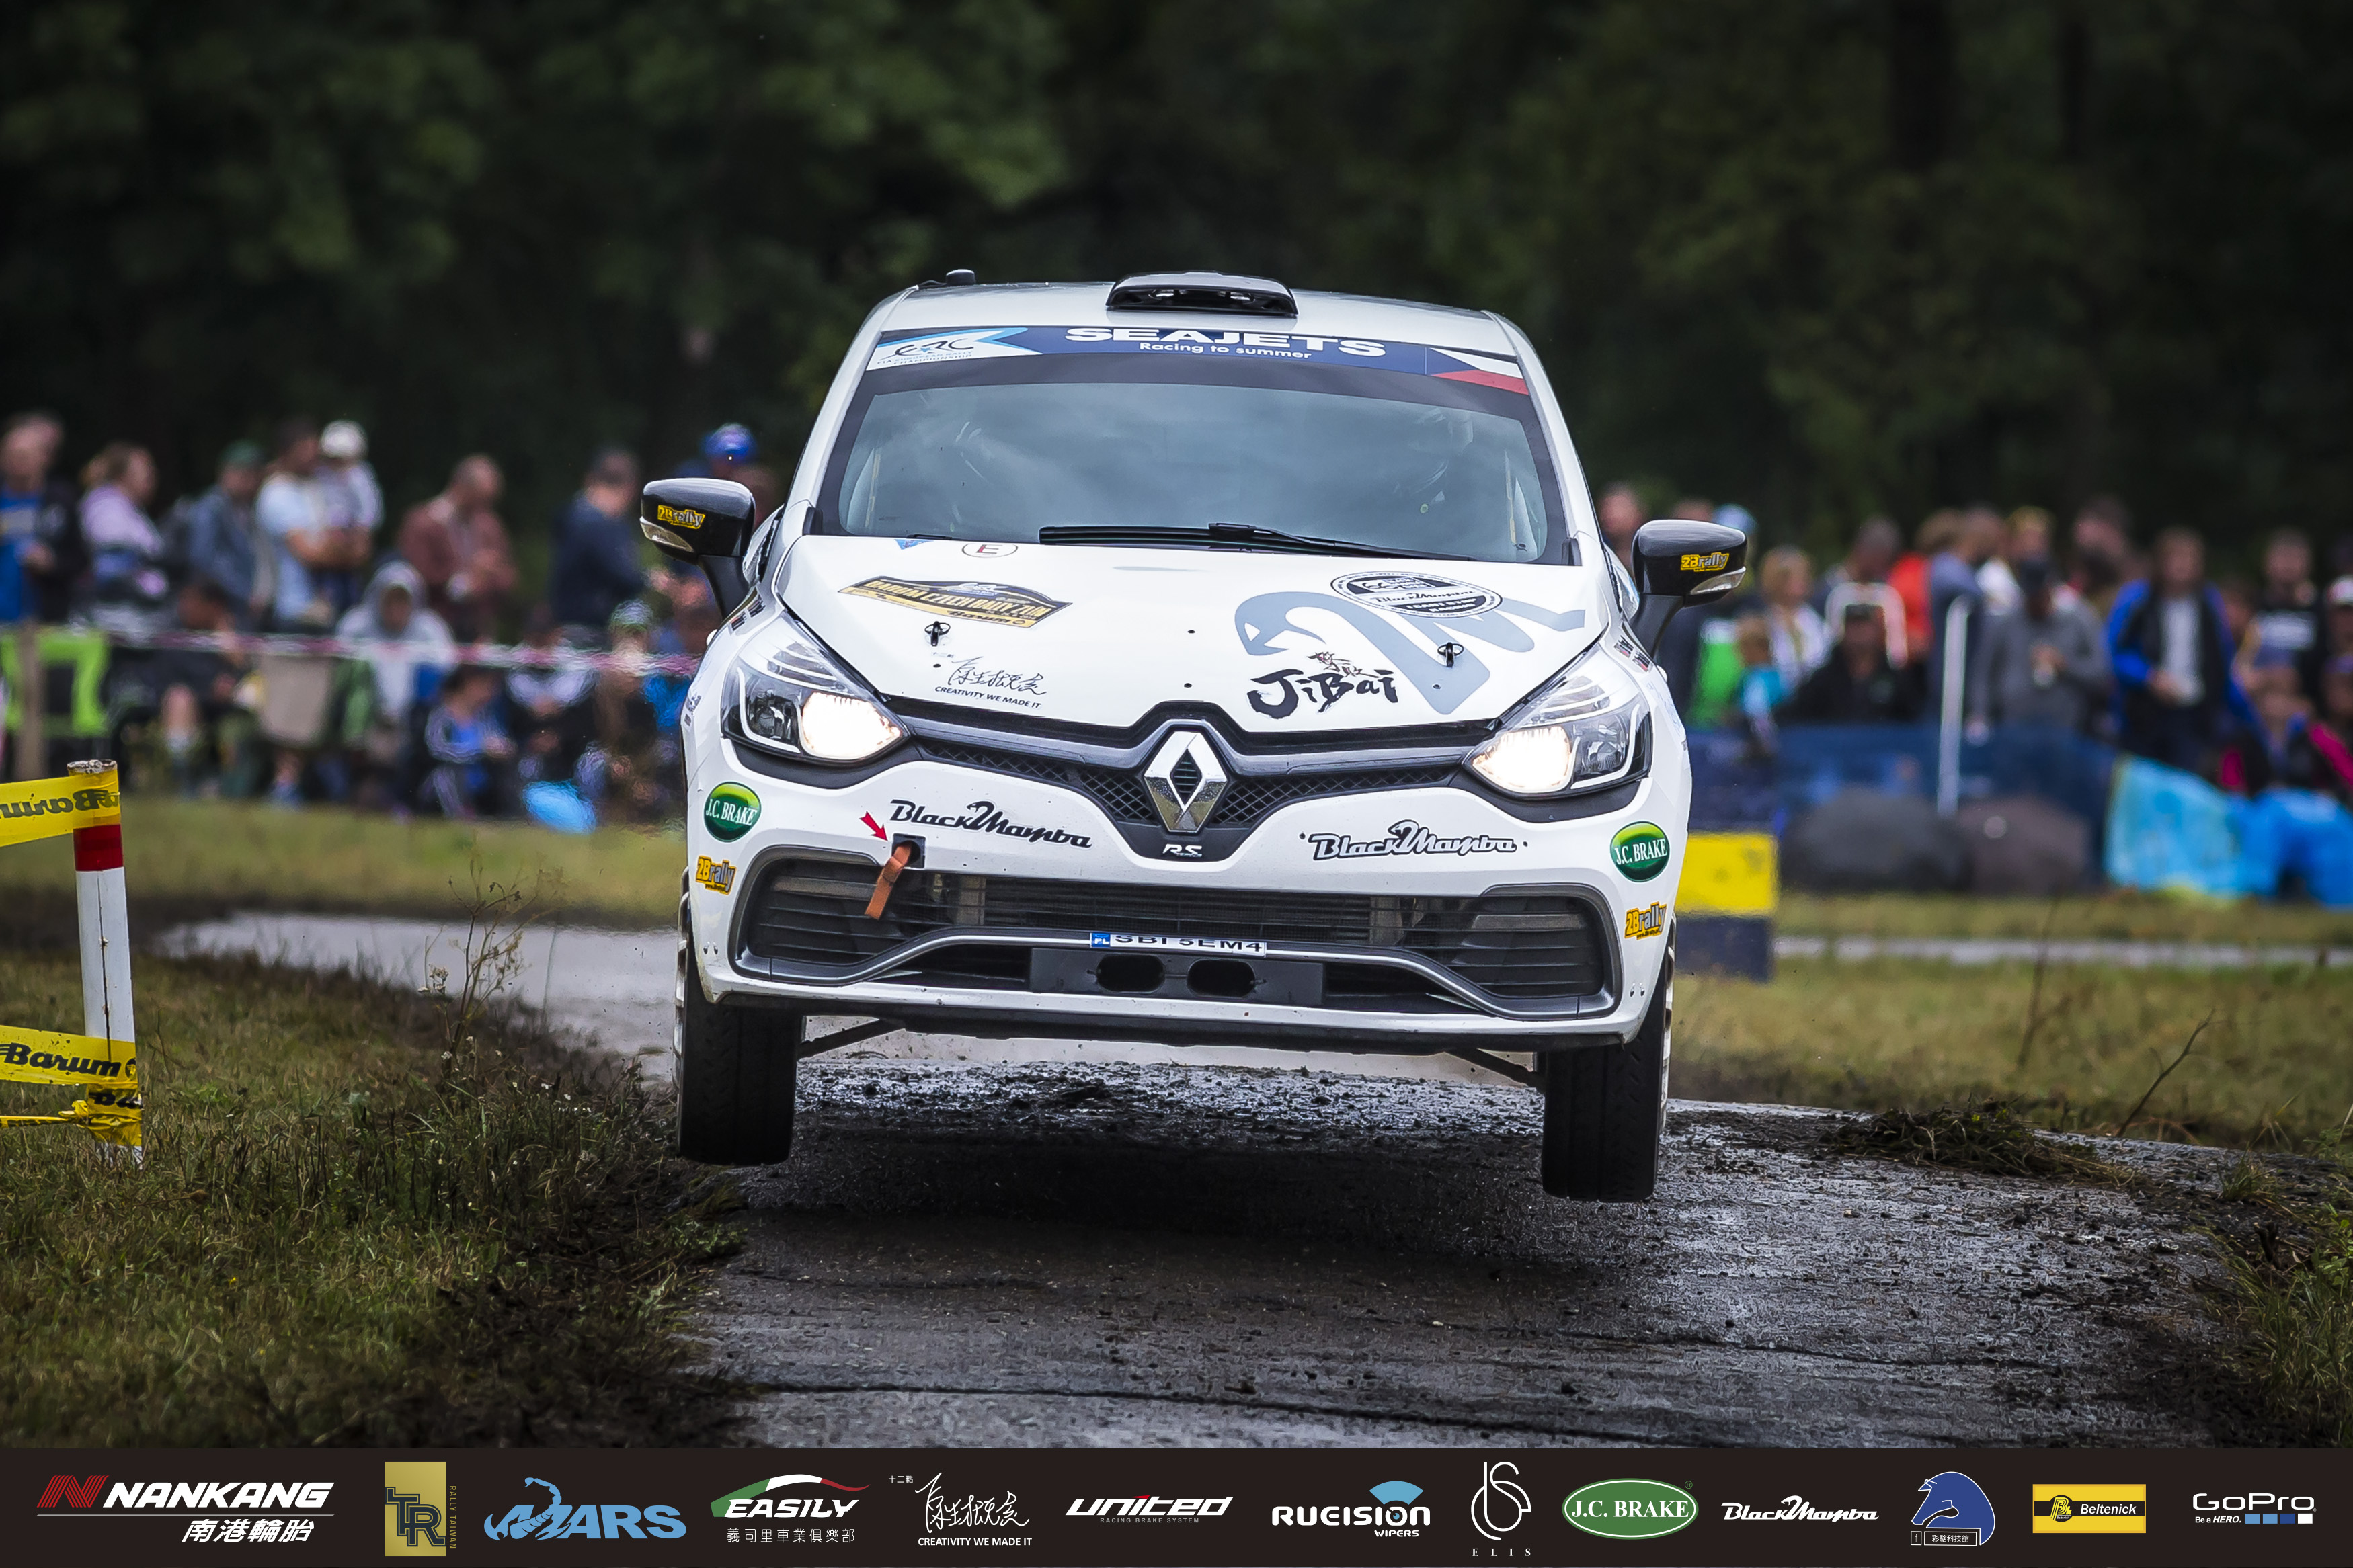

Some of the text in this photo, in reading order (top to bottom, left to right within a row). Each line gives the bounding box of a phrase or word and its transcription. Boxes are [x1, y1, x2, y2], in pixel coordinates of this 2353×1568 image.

[1064, 327, 1386, 357] SEAJETS
[1140, 341, 1312, 358] Racing to summer
[1681, 553, 1728, 568] 2Brally
[934, 686, 986, 698] CREATIVITY
[986, 694, 1001, 702] WE
[1002, 696, 1031, 708] MADE
[705, 798, 758, 827] J.C. BRAKE
[889, 799, 1093, 849] BlackMamba
[1308, 819, 1517, 860] BlackMamba
[1614, 838, 1667, 865] J.C. BRAKE
[696, 856, 735, 893] 2Brally
[1626, 905, 1667, 935] 2Brally
[0, 1042, 122, 1077] Barum
